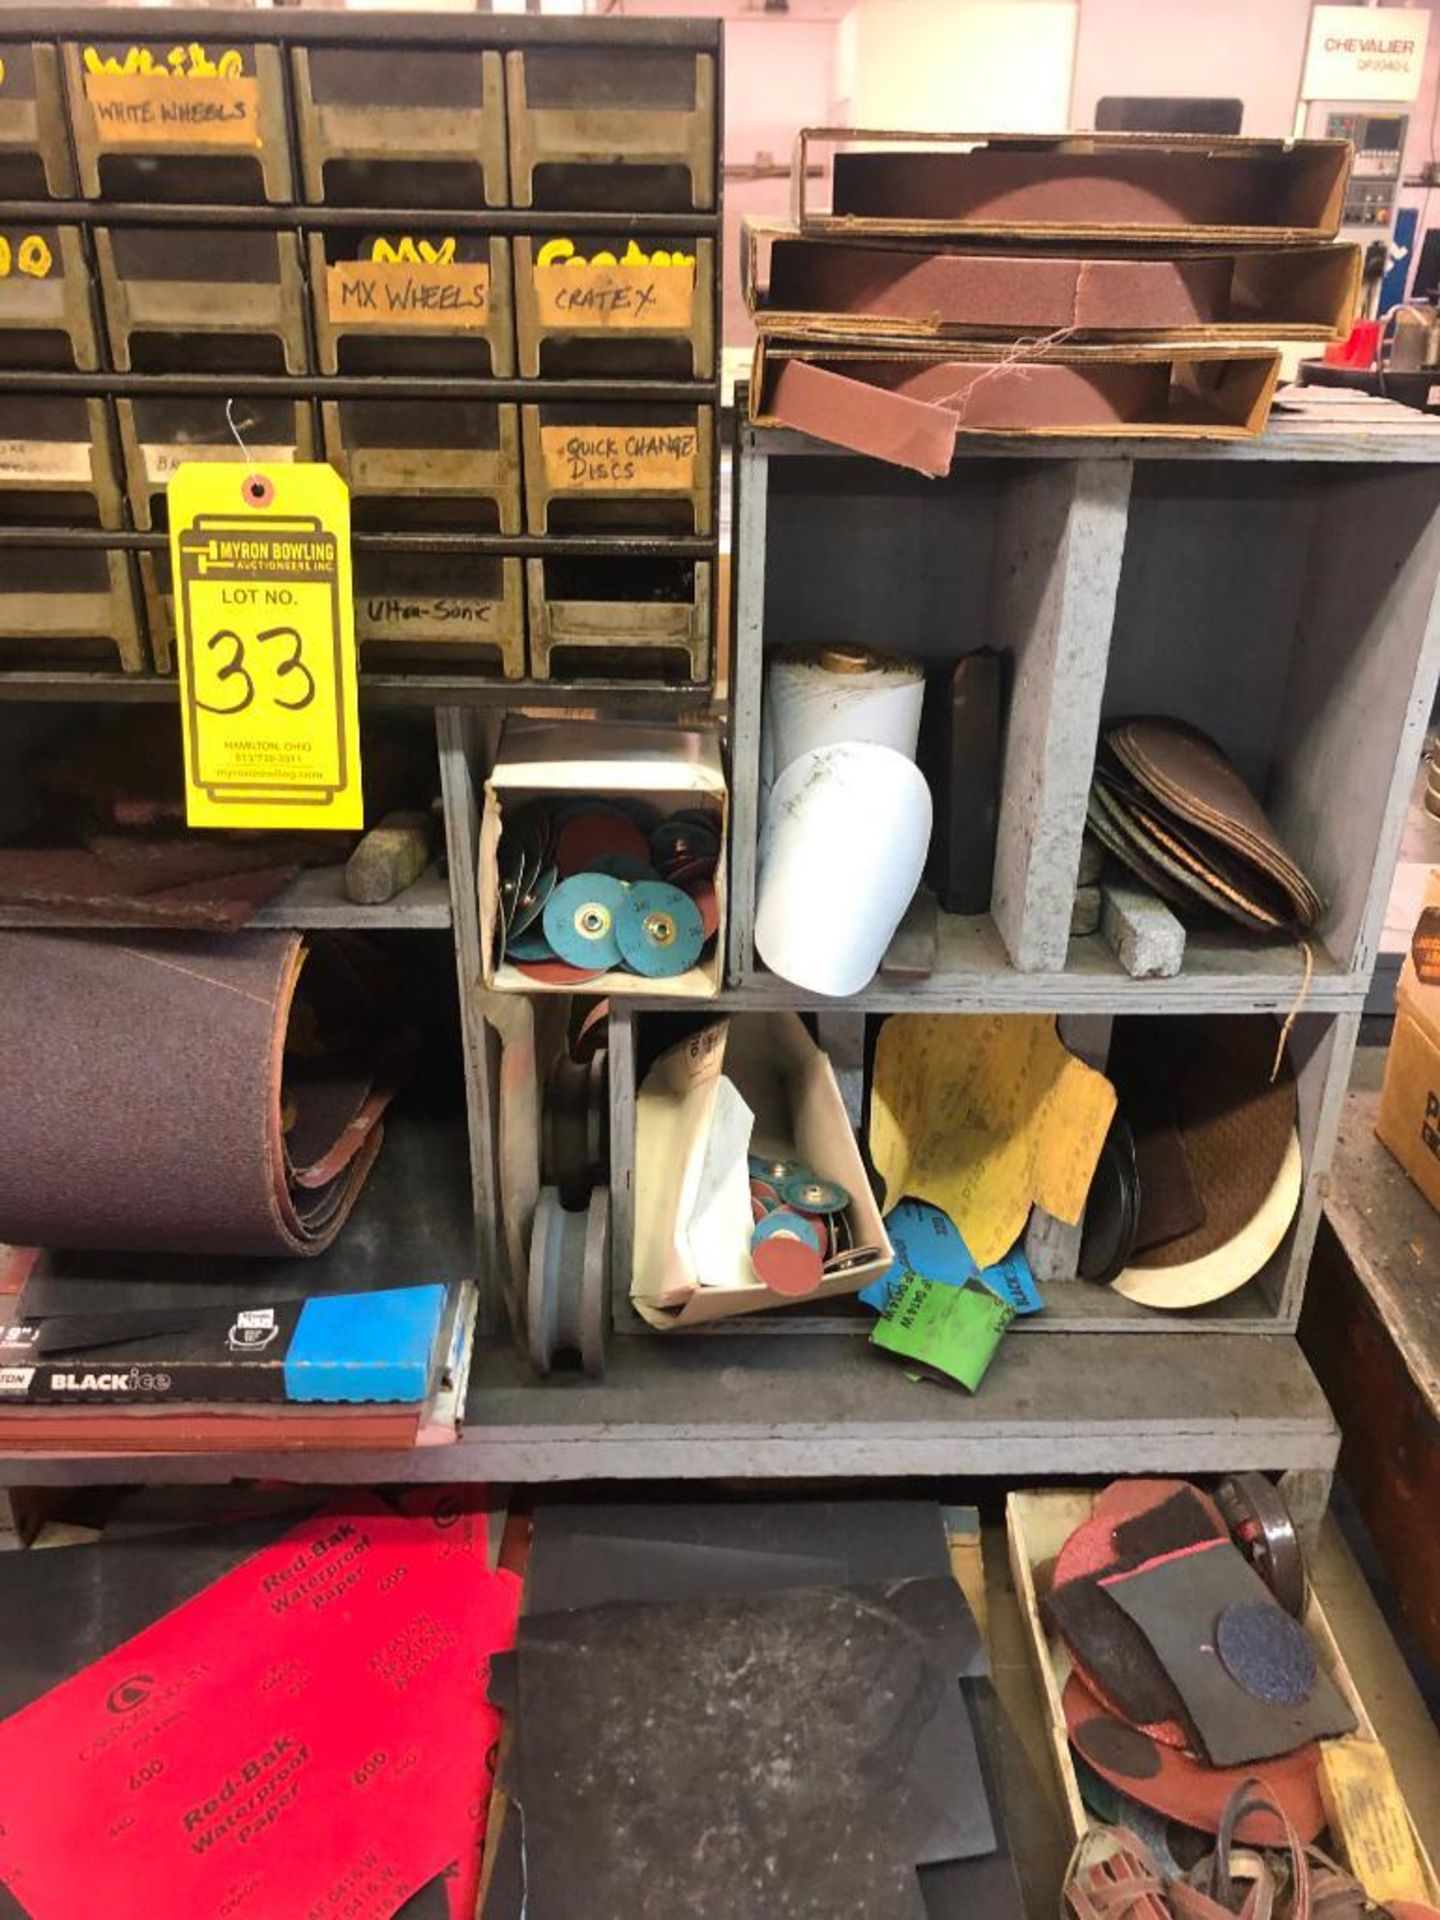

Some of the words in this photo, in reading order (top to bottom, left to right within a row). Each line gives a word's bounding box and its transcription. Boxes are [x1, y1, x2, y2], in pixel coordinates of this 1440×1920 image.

[1324, 37, 1415, 55] CHEVALIER
[100, 103, 153, 122] WHITE
[161, 102, 245, 122] WHEELS
[342, 280, 376, 309] MX
[385, 280, 486, 311] WHEELS
[566, 436, 616, 460] QUICK
[625, 434, 695, 460] CHANGE
[220, 542, 269, 560] MYRON
[273, 543, 335, 561] BOWLING
[236, 560, 311, 571] AUCTIONEERS
[222, 590, 258, 605] LOT
[265, 591, 299, 606] NO.
[194, 627, 316, 714] 33
[284, 742, 312, 752] OHIO
[261, 1523, 356, 1594] Red-Bak
[270, 1534, 373, 1615] Waterproof
[311, 1566, 365, 1611] Paper
[378, 1565, 409, 1593] 600
[130, 1760, 165, 1791] 600
[354, 1752, 387, 1785] 600
[182, 1737, 294, 1832] Red-Bak
[192, 1745, 310, 1854] Waterproof
[238, 1781, 298, 1842] Paper
